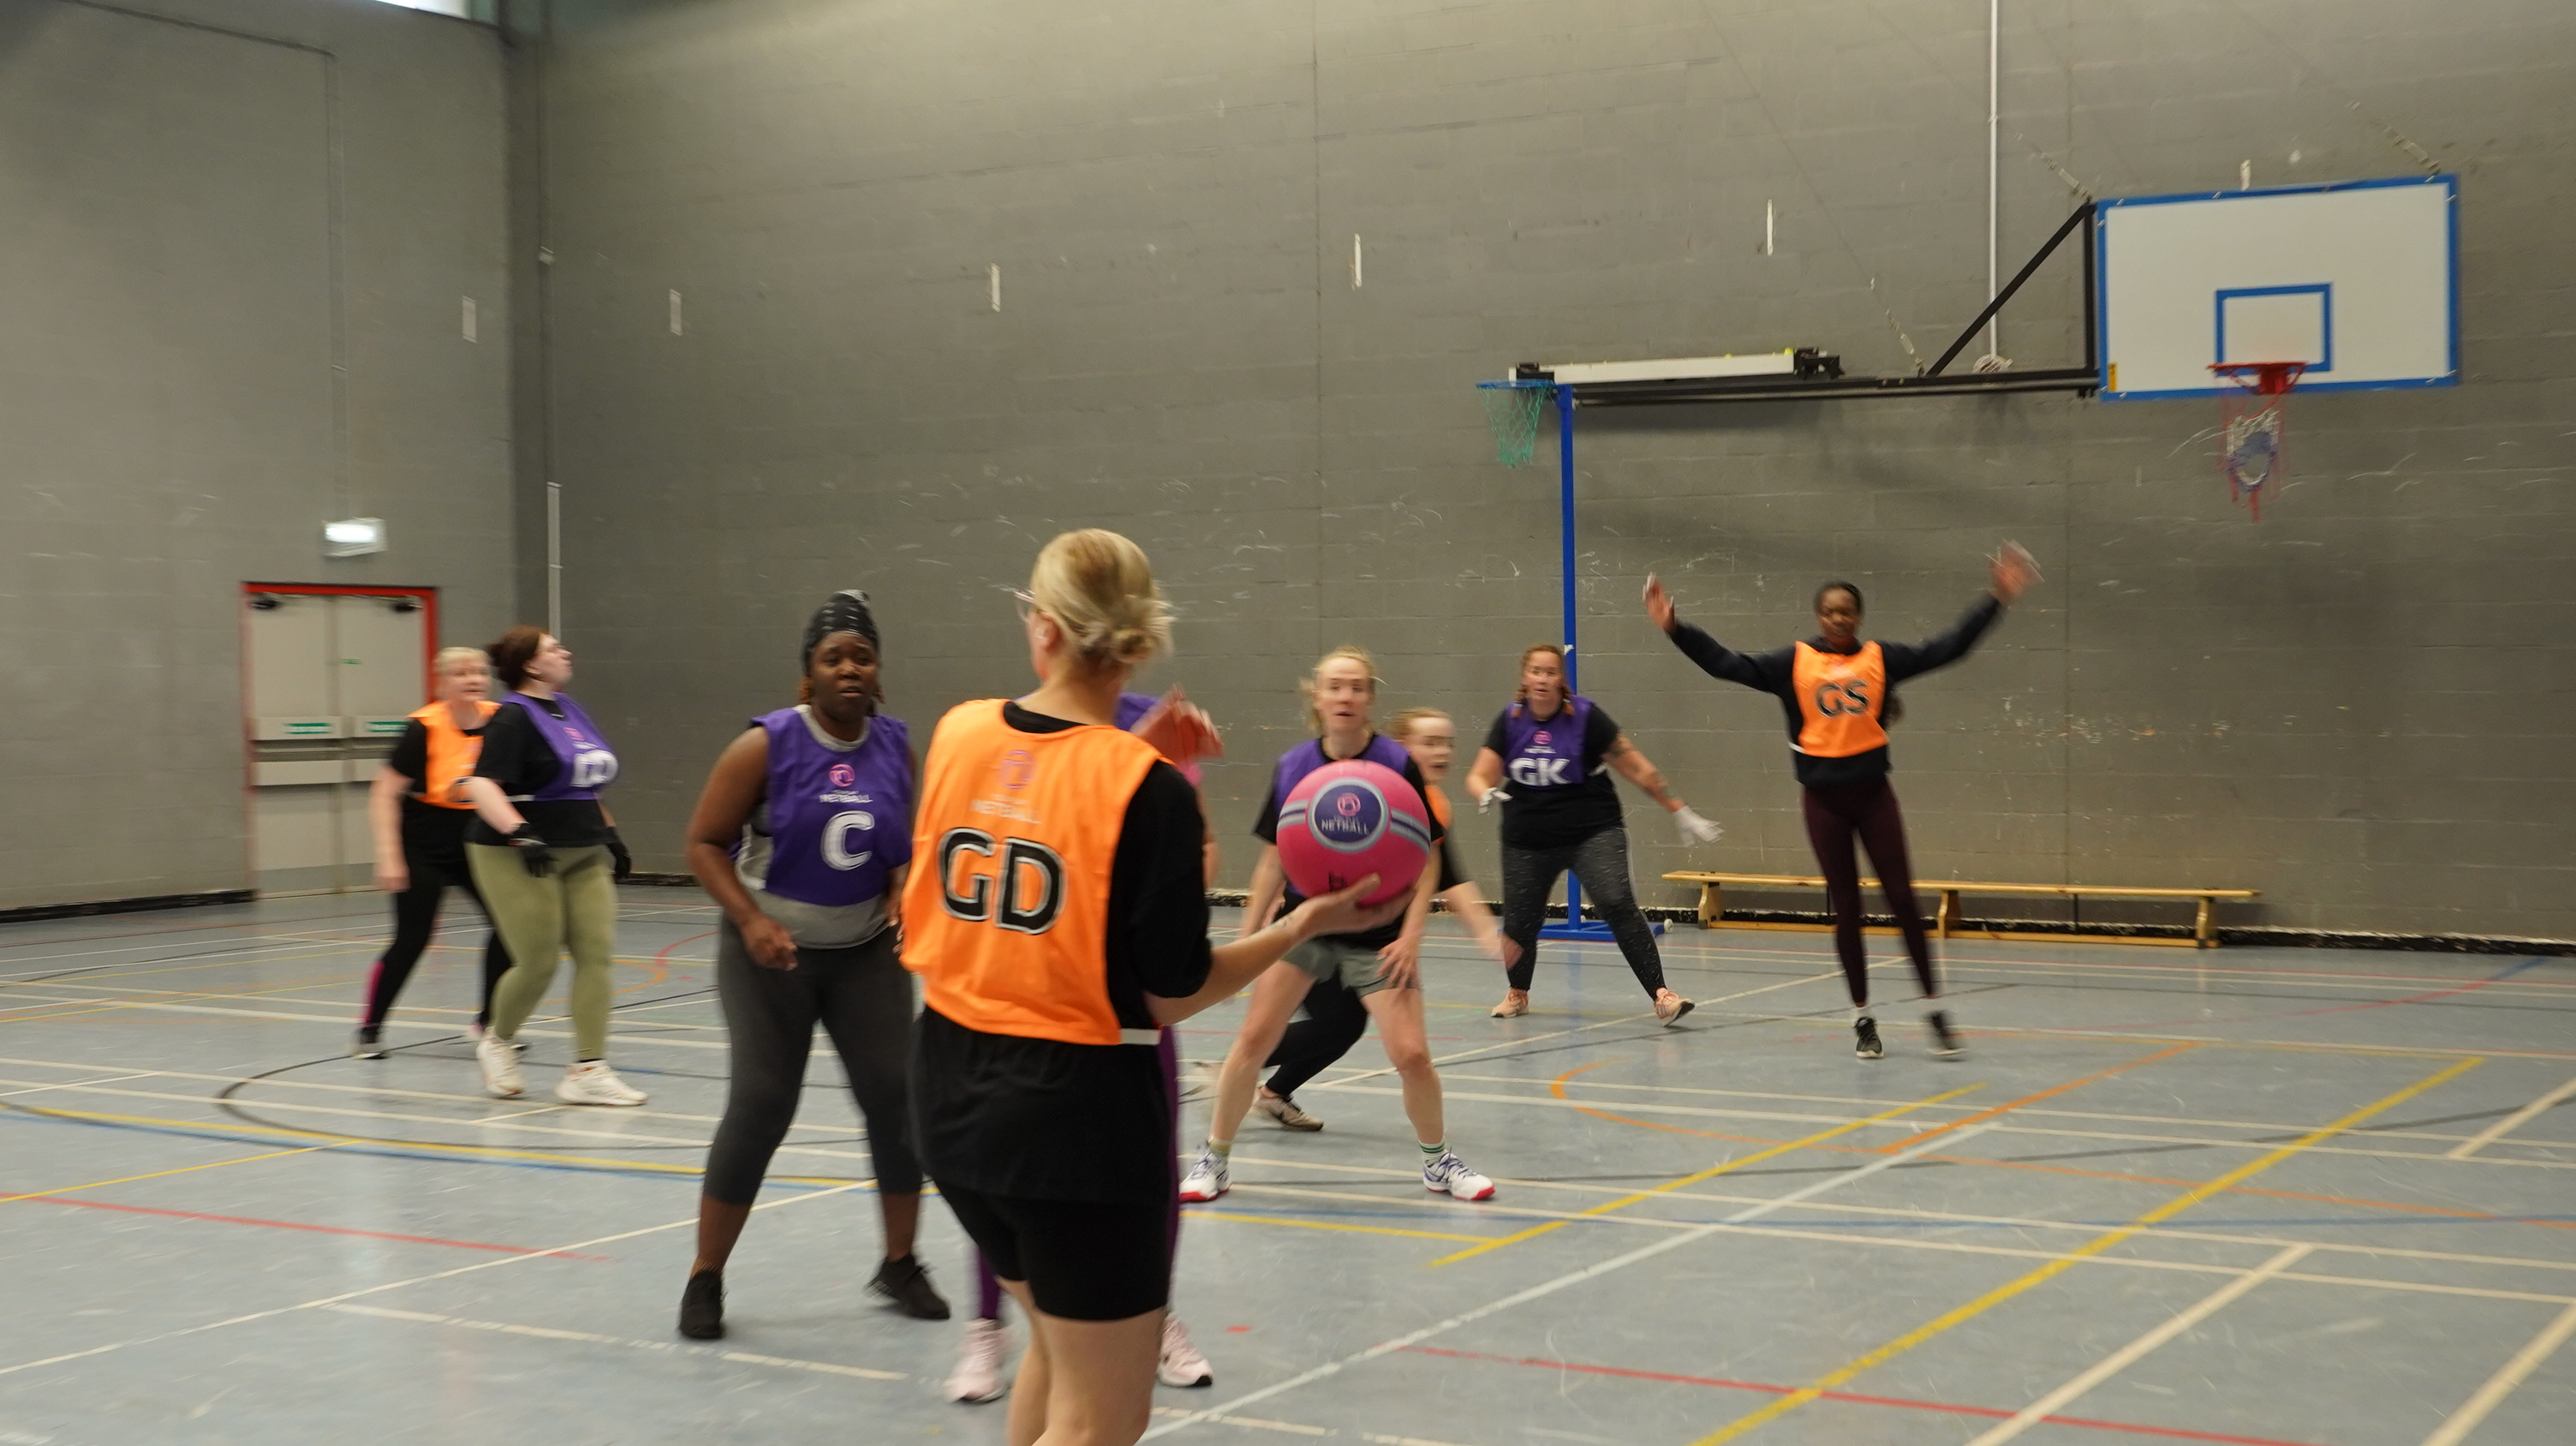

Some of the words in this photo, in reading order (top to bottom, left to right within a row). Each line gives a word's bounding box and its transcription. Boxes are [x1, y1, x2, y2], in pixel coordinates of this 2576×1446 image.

[1816, 678, 1869, 718] GS
[1508, 757, 1571, 786] GK
[820, 810, 875, 871] C
[1321, 818, 1369, 836] NETBALL
[938, 826, 1069, 935] GD
